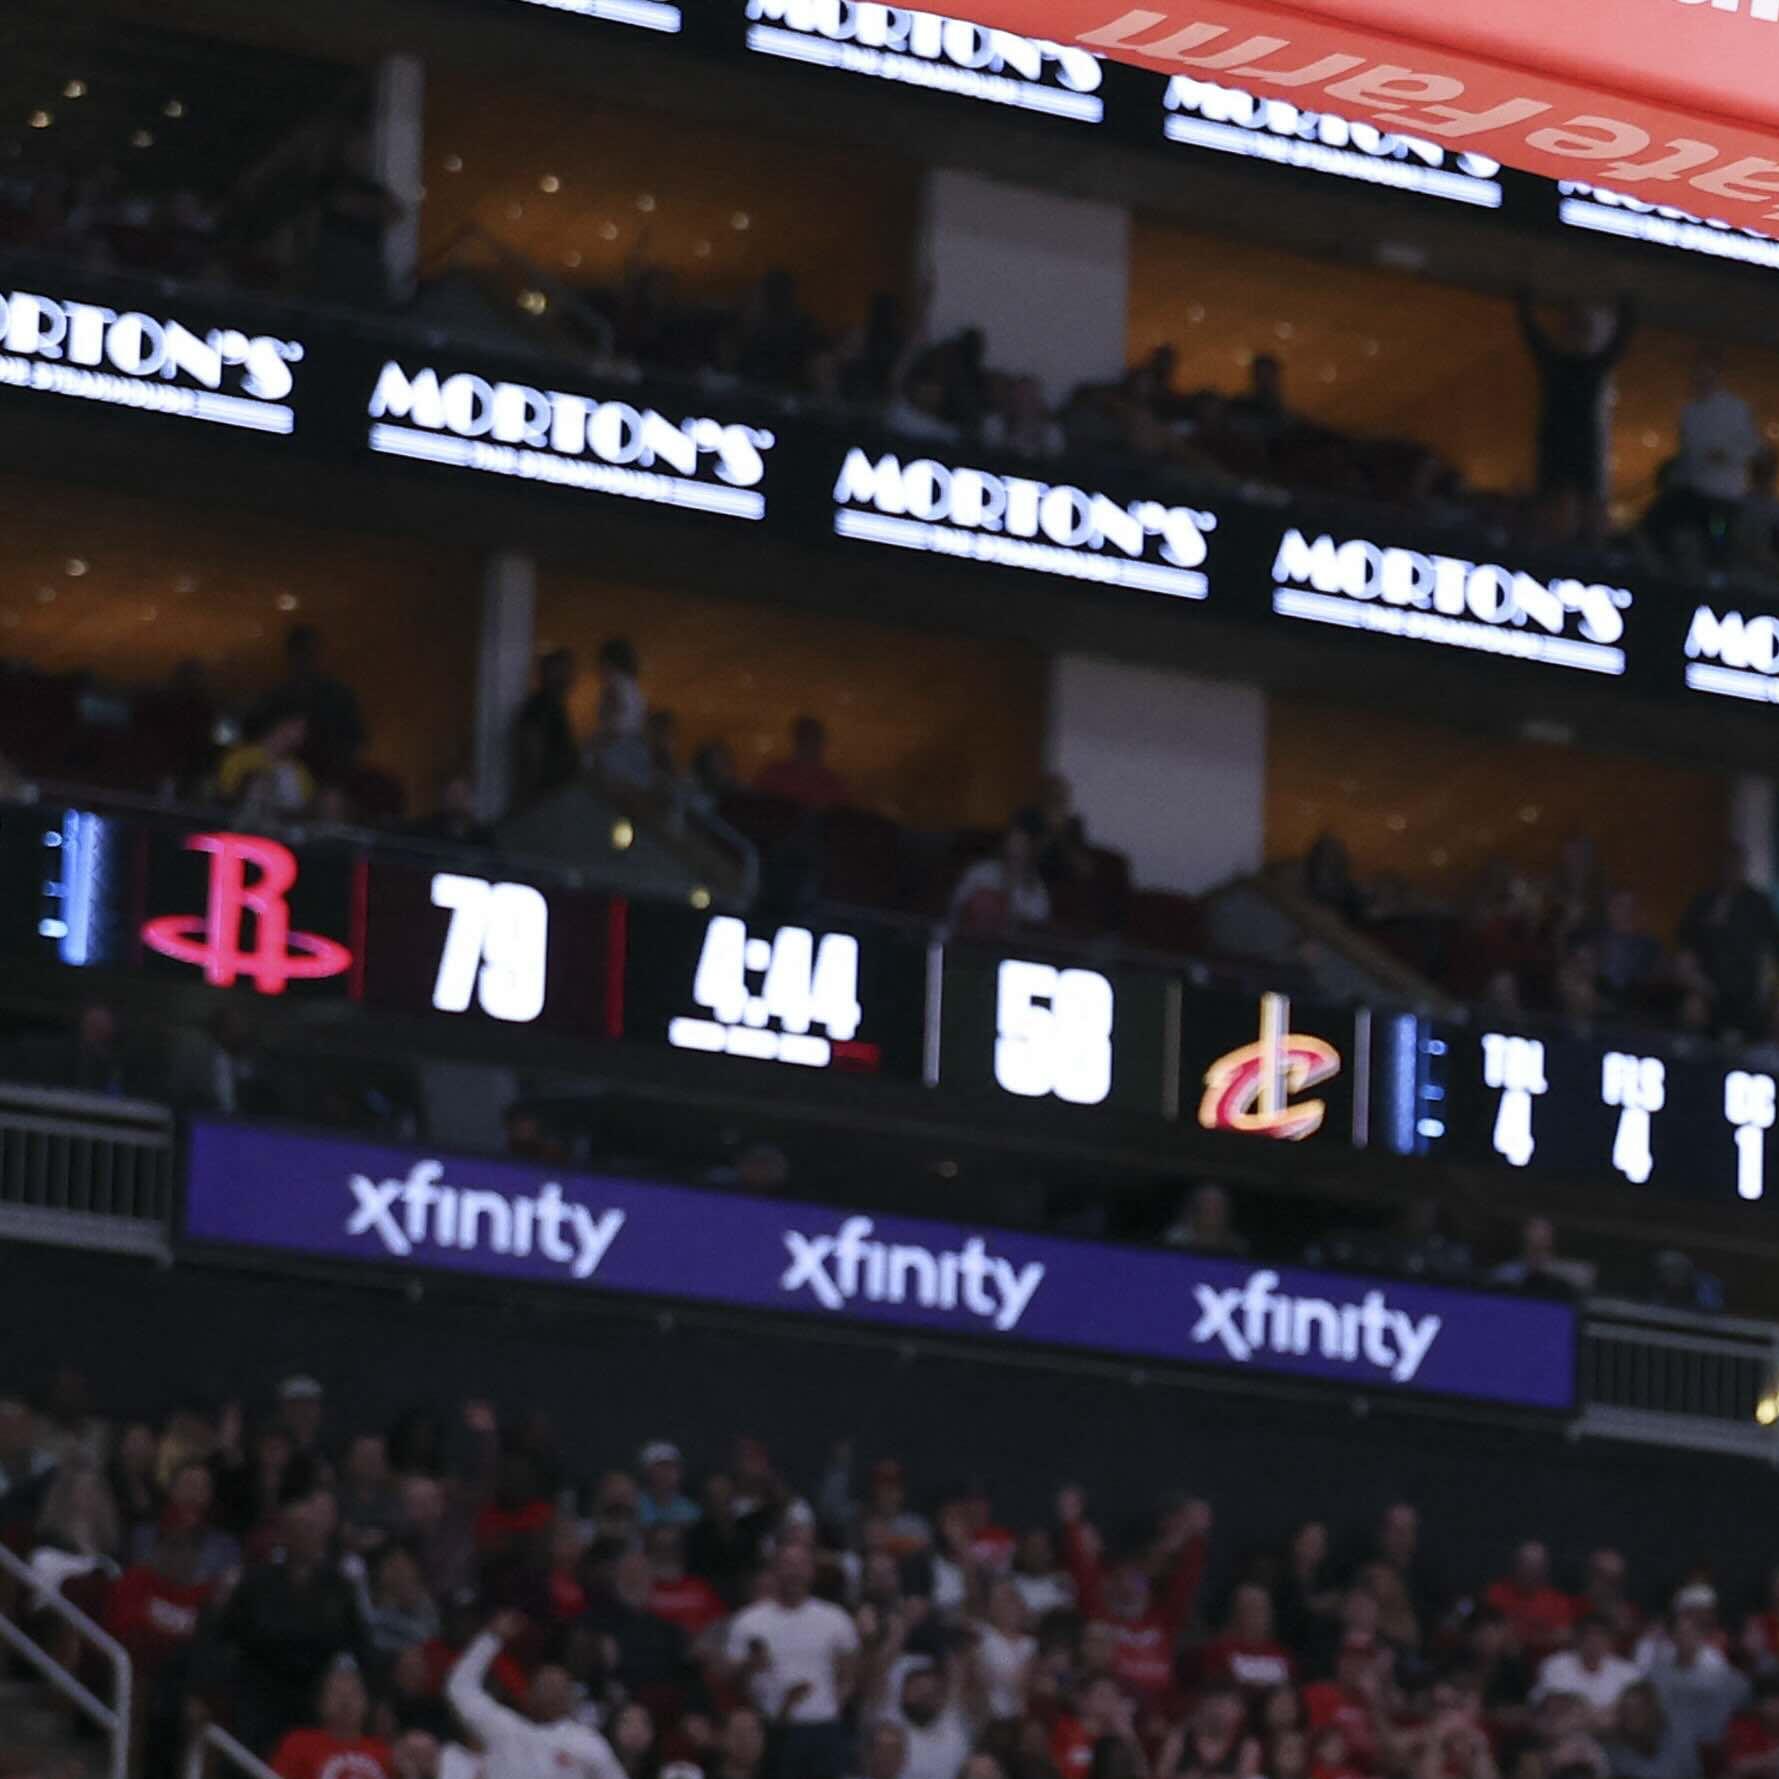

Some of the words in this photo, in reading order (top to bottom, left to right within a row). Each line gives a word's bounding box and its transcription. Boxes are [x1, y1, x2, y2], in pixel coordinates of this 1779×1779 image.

[1075, 8, 1552, 138] Farm
[368, 361, 776, 487] MORTON'S
[833, 447, 1218, 568] MORTON'S
[1271, 528, 1633, 644] MORTON'S
[345, 1159, 627, 1279] xfinity
[779, 1215, 1046, 1331] xfinity
[1190, 1269, 1442, 1383] xfinity
